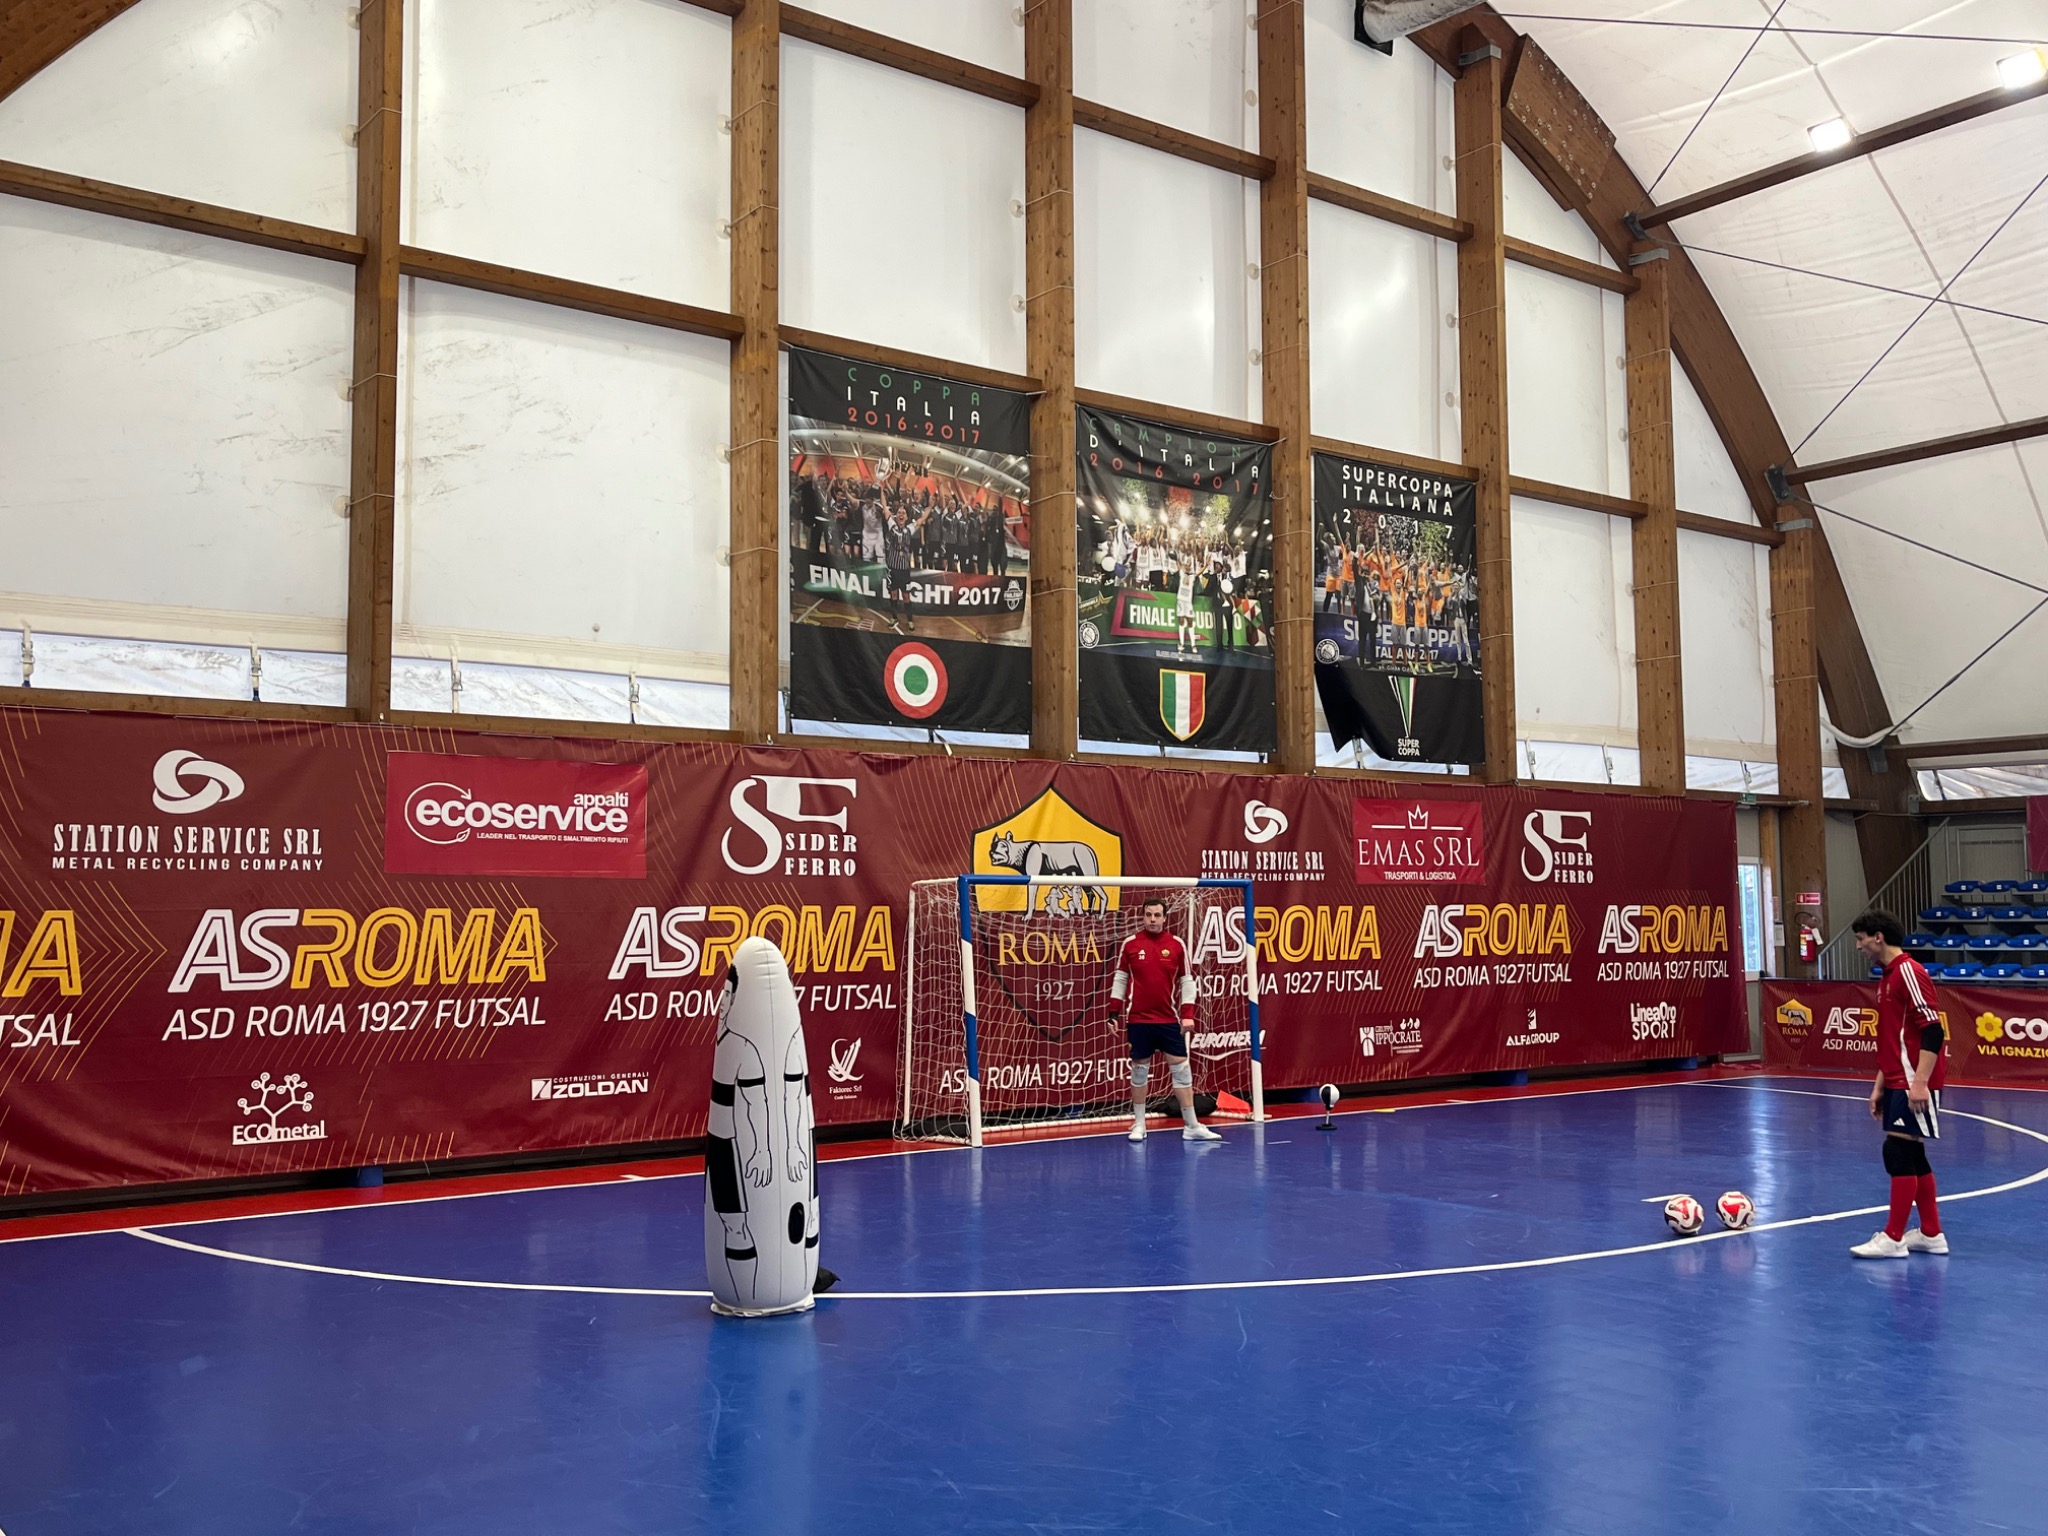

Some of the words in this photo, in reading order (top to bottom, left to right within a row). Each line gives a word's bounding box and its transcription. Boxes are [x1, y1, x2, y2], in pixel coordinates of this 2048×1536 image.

[848, 367, 980, 406] COPPA
[848, 386, 980, 426] ITALIA
[1090, 417, 1259, 461] CAMPIONI
[1342, 464, 1453, 499] SUPERCOPPA
[1342, 483, 1453, 517] ITALIANA
[1342, 508, 1453, 540] 2017
[809, 564, 876, 598] FINAL
[958, 587, 1002, 606] 2017
[1129, 604, 1175, 628] FINALE
[1397, 738, 1420, 748] SUPER
[1397, 747, 1420, 757] COPPA
[573, 791, 629, 809] appalti
[415, 798, 629, 833] ecoservice
[53, 823, 160, 853] STATION
[173, 826, 270, 854] SERVICE
[283, 828, 322, 855] SRL
[518, 833, 557, 841] TRASPORTO
[563, 835, 606, 843] SMALTIMENTO
[607, 836, 629, 844] RIFIUTI
[785, 832, 857, 852] SIDER
[1201, 849, 1249, 870] STATION
[1256, 850, 1299, 871] SERVICE
[1305, 851, 1324, 871] SRL
[1357, 838, 1425, 866] EMAS
[1433, 836, 1480, 868] SRL
[1554, 851, 1593, 866] SIDER
[52, 857, 115, 870] METAL
[127, 857, 230, 870] RECYCLING
[241, 858, 323, 871] COMPANY
[784, 857, 857, 876] FERRO
[1284, 872, 1325, 882] COMPANY
[1384, 871, 1419, 880] TRASPORTI
[1425, 871, 1457, 881] LOGISTICA
[1554, 869, 1594, 884] FERRO
[998, 931, 1104, 966] ROMA
[1413, 967, 1441, 989] ASD
[1444, 965, 1490, 987] ROMA
[1493, 964, 1527, 985] 1927
[1526, 963, 1572, 984] FUTSAL
[1597, 962, 1622, 982] ASD
[1625, 961, 1661, 981] ROMA
[1664, 960, 1691, 980] 1927
[1693, 960, 1729, 979] FUTSAL
[1034, 981, 1075, 1002] 1927
[1195, 975, 1225, 998] ASD
[1283, 971, 1323, 994] 1927
[1326, 969, 1383, 993] FUTSAL
[604, 992, 657, 1021] ASD
[667, 989, 724, 1019] ROM
[810, 984, 897, 1011] FUTSAL
[162, 1007, 236, 1042] ASD
[245, 1003, 347, 1037] ROMA
[357, 1000, 429, 1032] 1927
[434, 996, 547, 1029] FUTSAL
[1375, 1030, 1422, 1045] IPPOCRATE
[1632, 1020, 1676, 1041] SPORT
[1782, 1026, 1808, 1036] ROMA
[1822, 1039, 1843, 1050] ASD
[1845, 1039, 1878, 1052] ROMA
[1977, 1044, 1999, 1056] VIA
[553, 1074, 606, 1084] COSTRUZIONI
[610, 1072, 649, 1080] GENERALI
[986, 1063, 1043, 1090] ROMA
[1048, 1060, 1094, 1085] 1927
[552, 1079, 649, 1099] ZOLDAN
